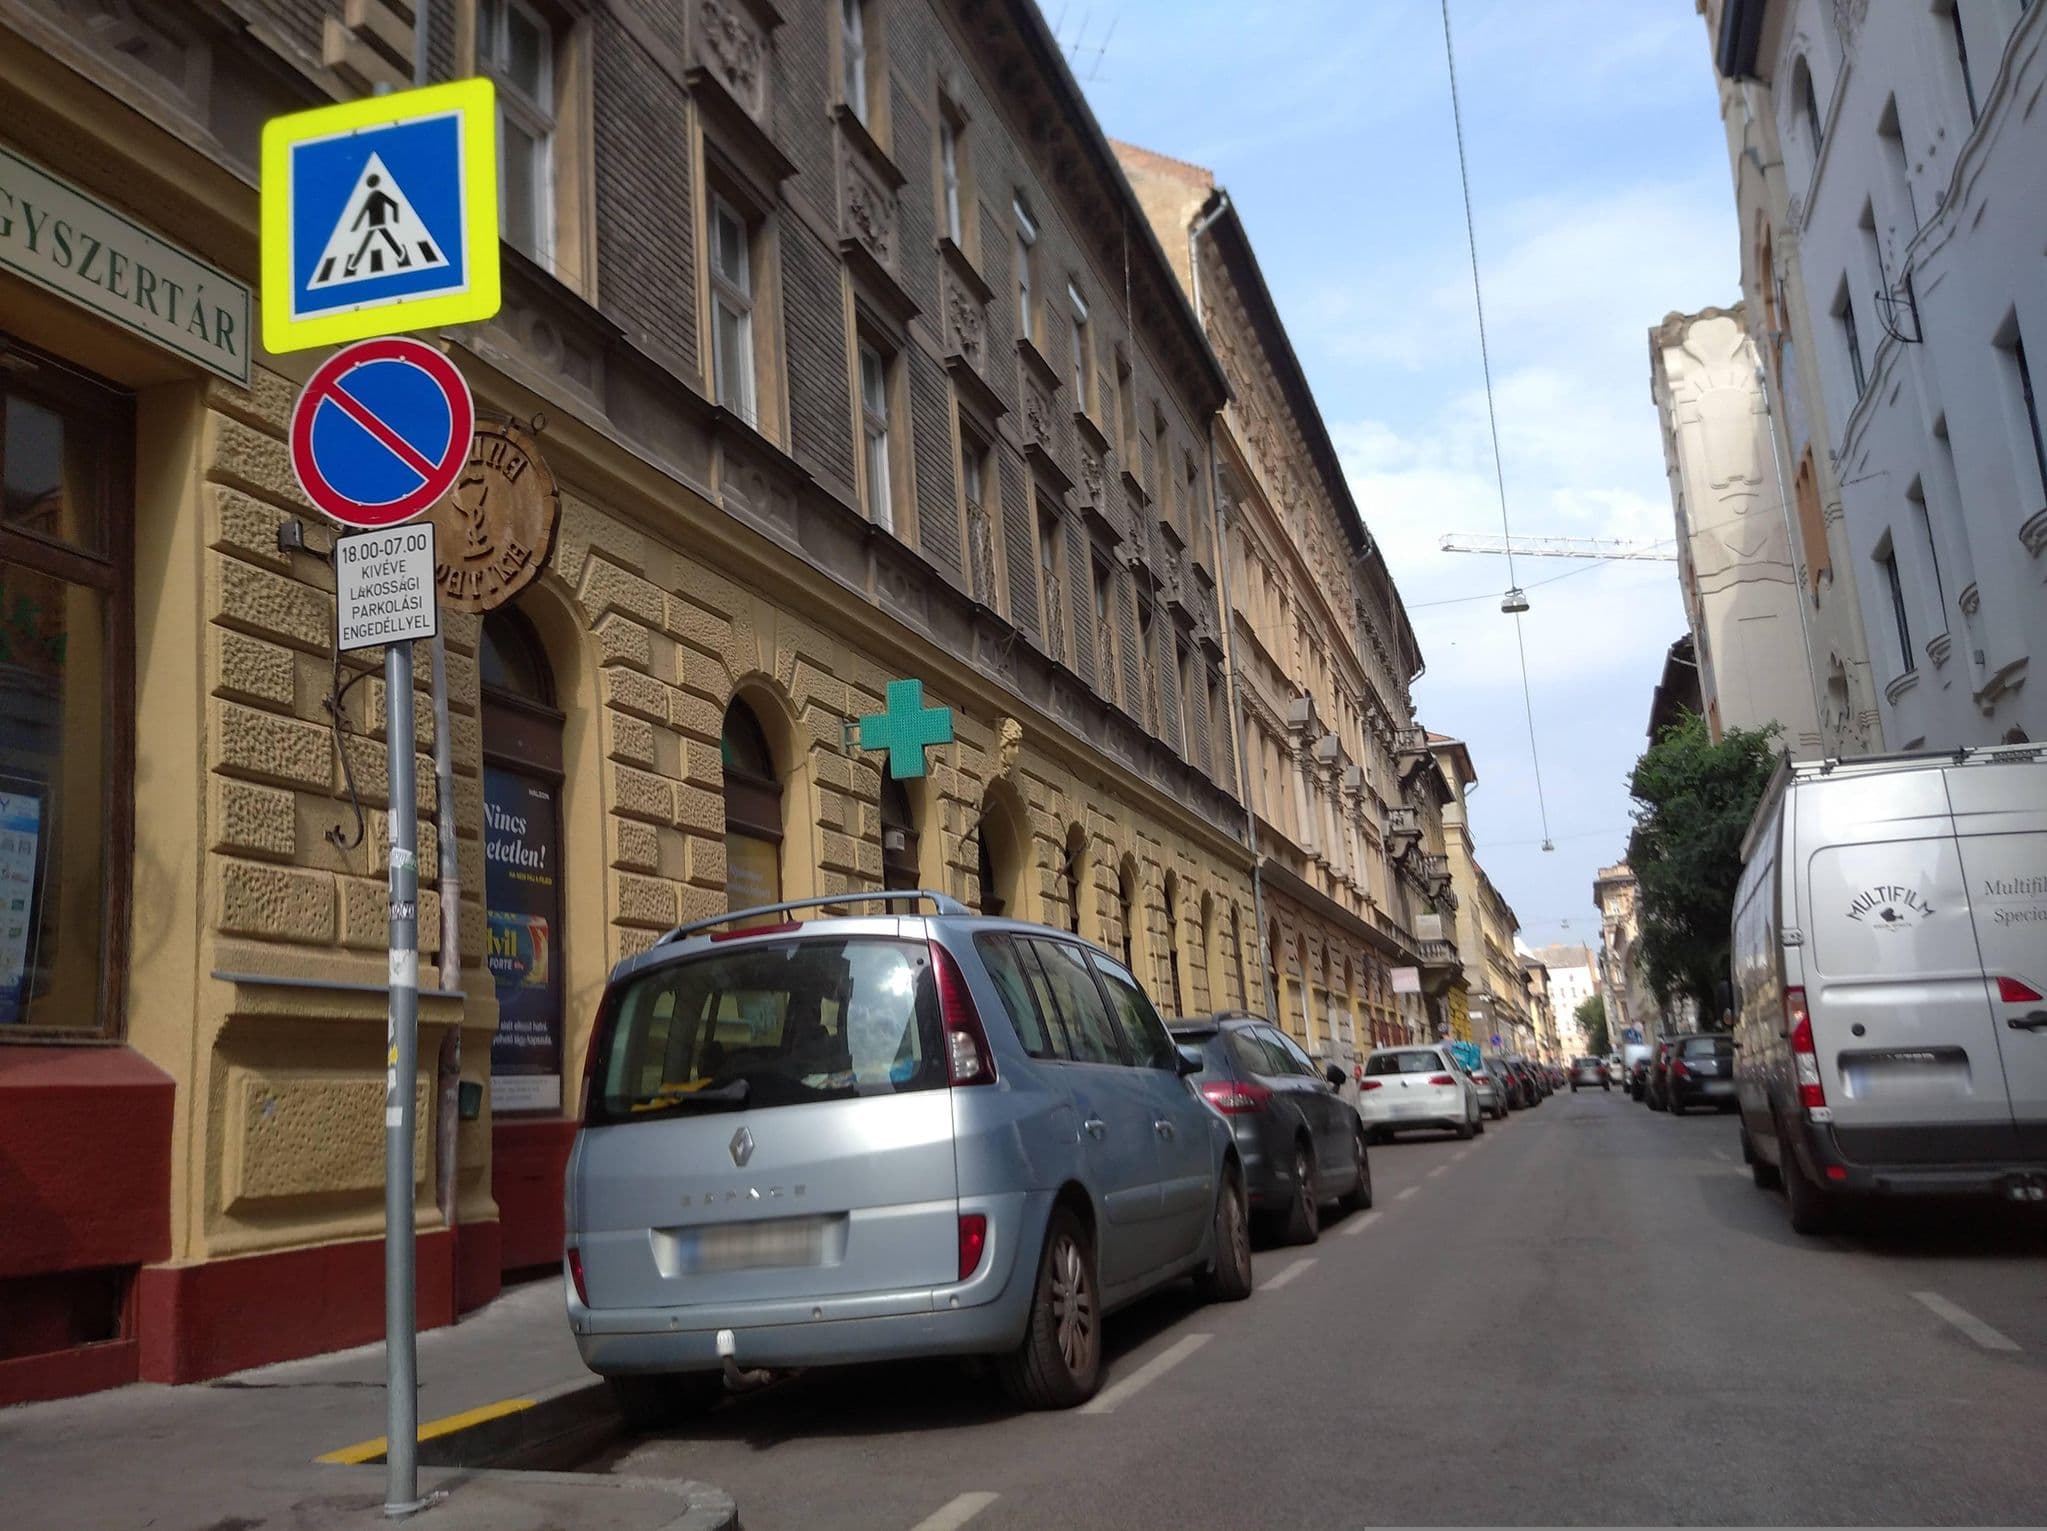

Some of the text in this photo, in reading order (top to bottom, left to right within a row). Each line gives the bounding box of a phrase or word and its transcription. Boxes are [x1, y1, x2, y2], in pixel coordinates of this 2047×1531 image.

[342, 533, 427, 564] 18.00-07.00
[361, 558, 407, 580] KIVÉVE
[350, 574, 420, 601] LAKOSSÁGI
[352, 593, 423, 620] PARKOLÁSI
[343, 614, 431, 641] ENGEDÉLLYEL
[484, 839, 546, 869] etetlen!
[1845, 886, 1936, 921] MULTIFILM
